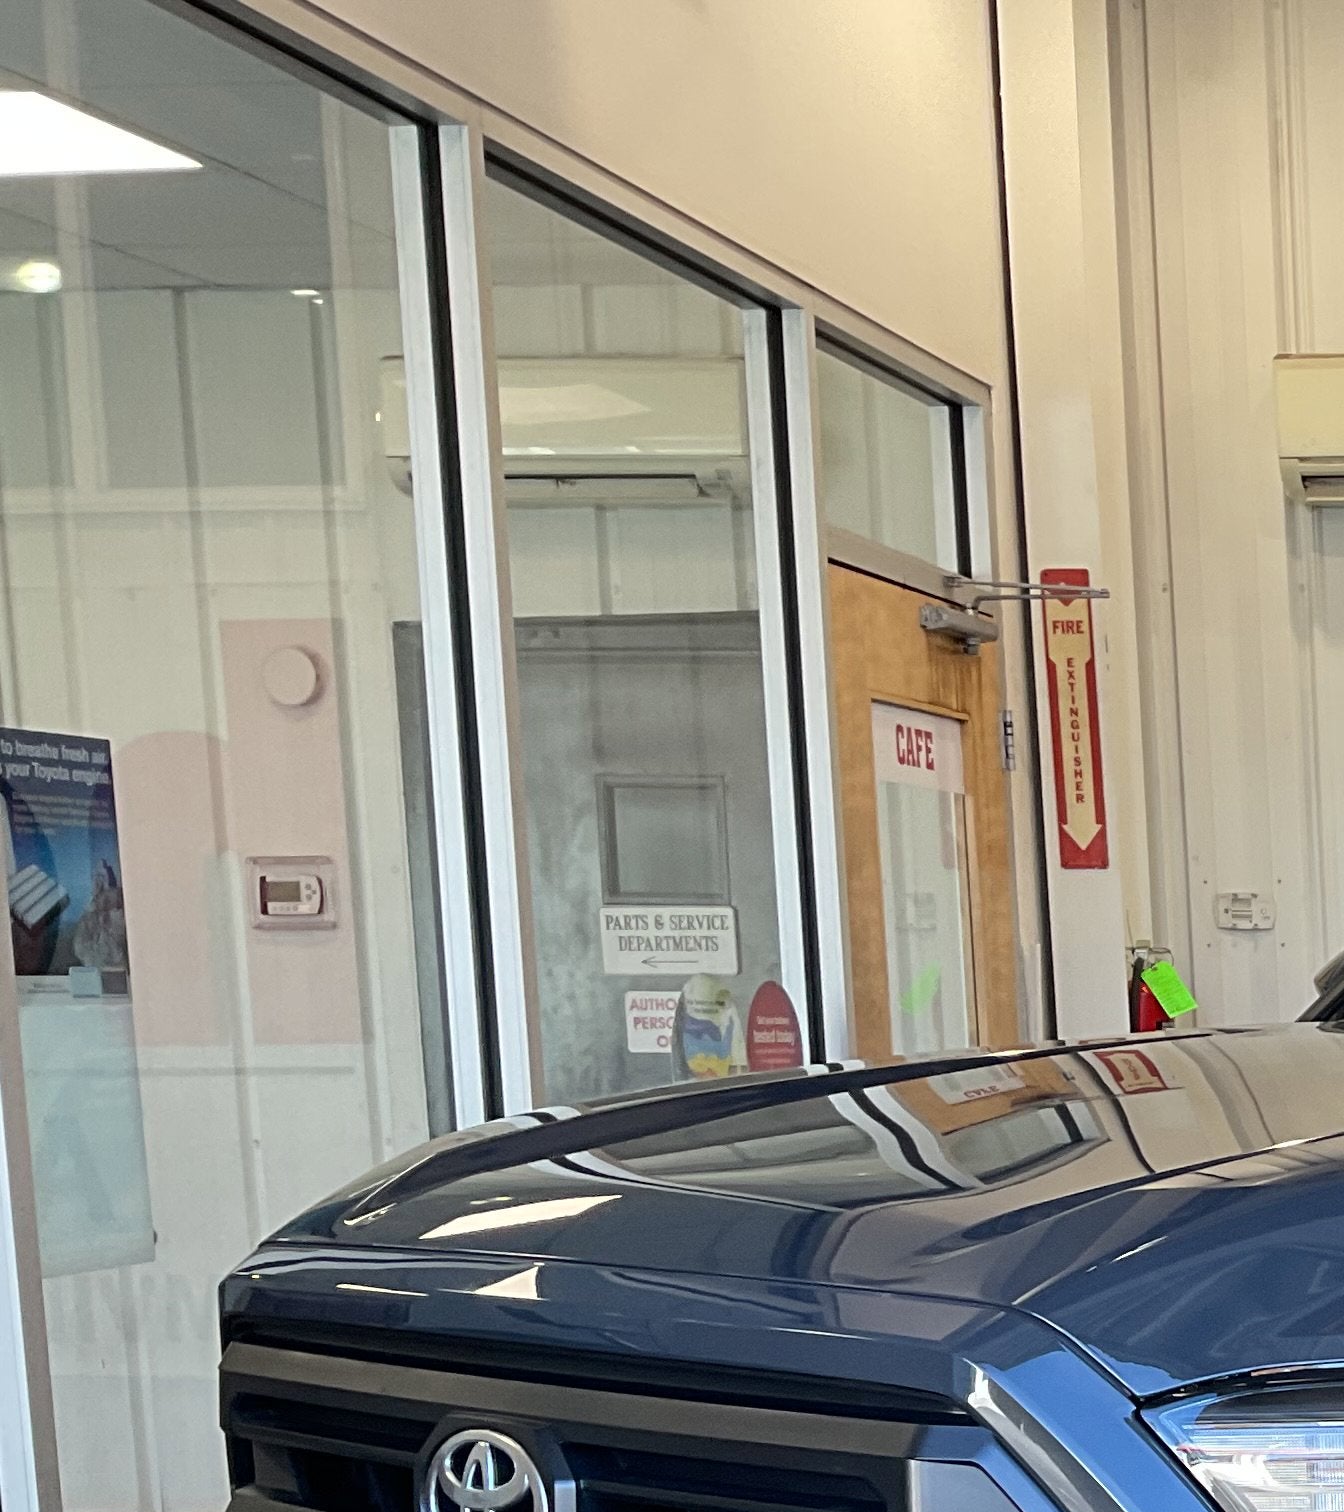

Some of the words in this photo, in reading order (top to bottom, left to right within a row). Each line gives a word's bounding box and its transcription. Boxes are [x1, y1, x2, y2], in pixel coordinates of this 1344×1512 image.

[1052, 620, 1085, 635] FIRE
[1066, 657, 1085, 804] EXTINGUISHER
[15, 740, 59, 760] breathe
[61, 744, 90, 763] fresh
[896, 723, 936, 771] CAFE
[5, 763, 30, 780] your
[32, 761, 70, 783] Toyota
[605, 914, 649, 931] PARTS
[655, 915, 665, 930] &
[669, 914, 730, 931] SERVICE
[618, 935, 720, 952] DEPARTMENTS
[630, 998, 677, 1011] AUTHO
[633, 1016, 674, 1030] PERSO
